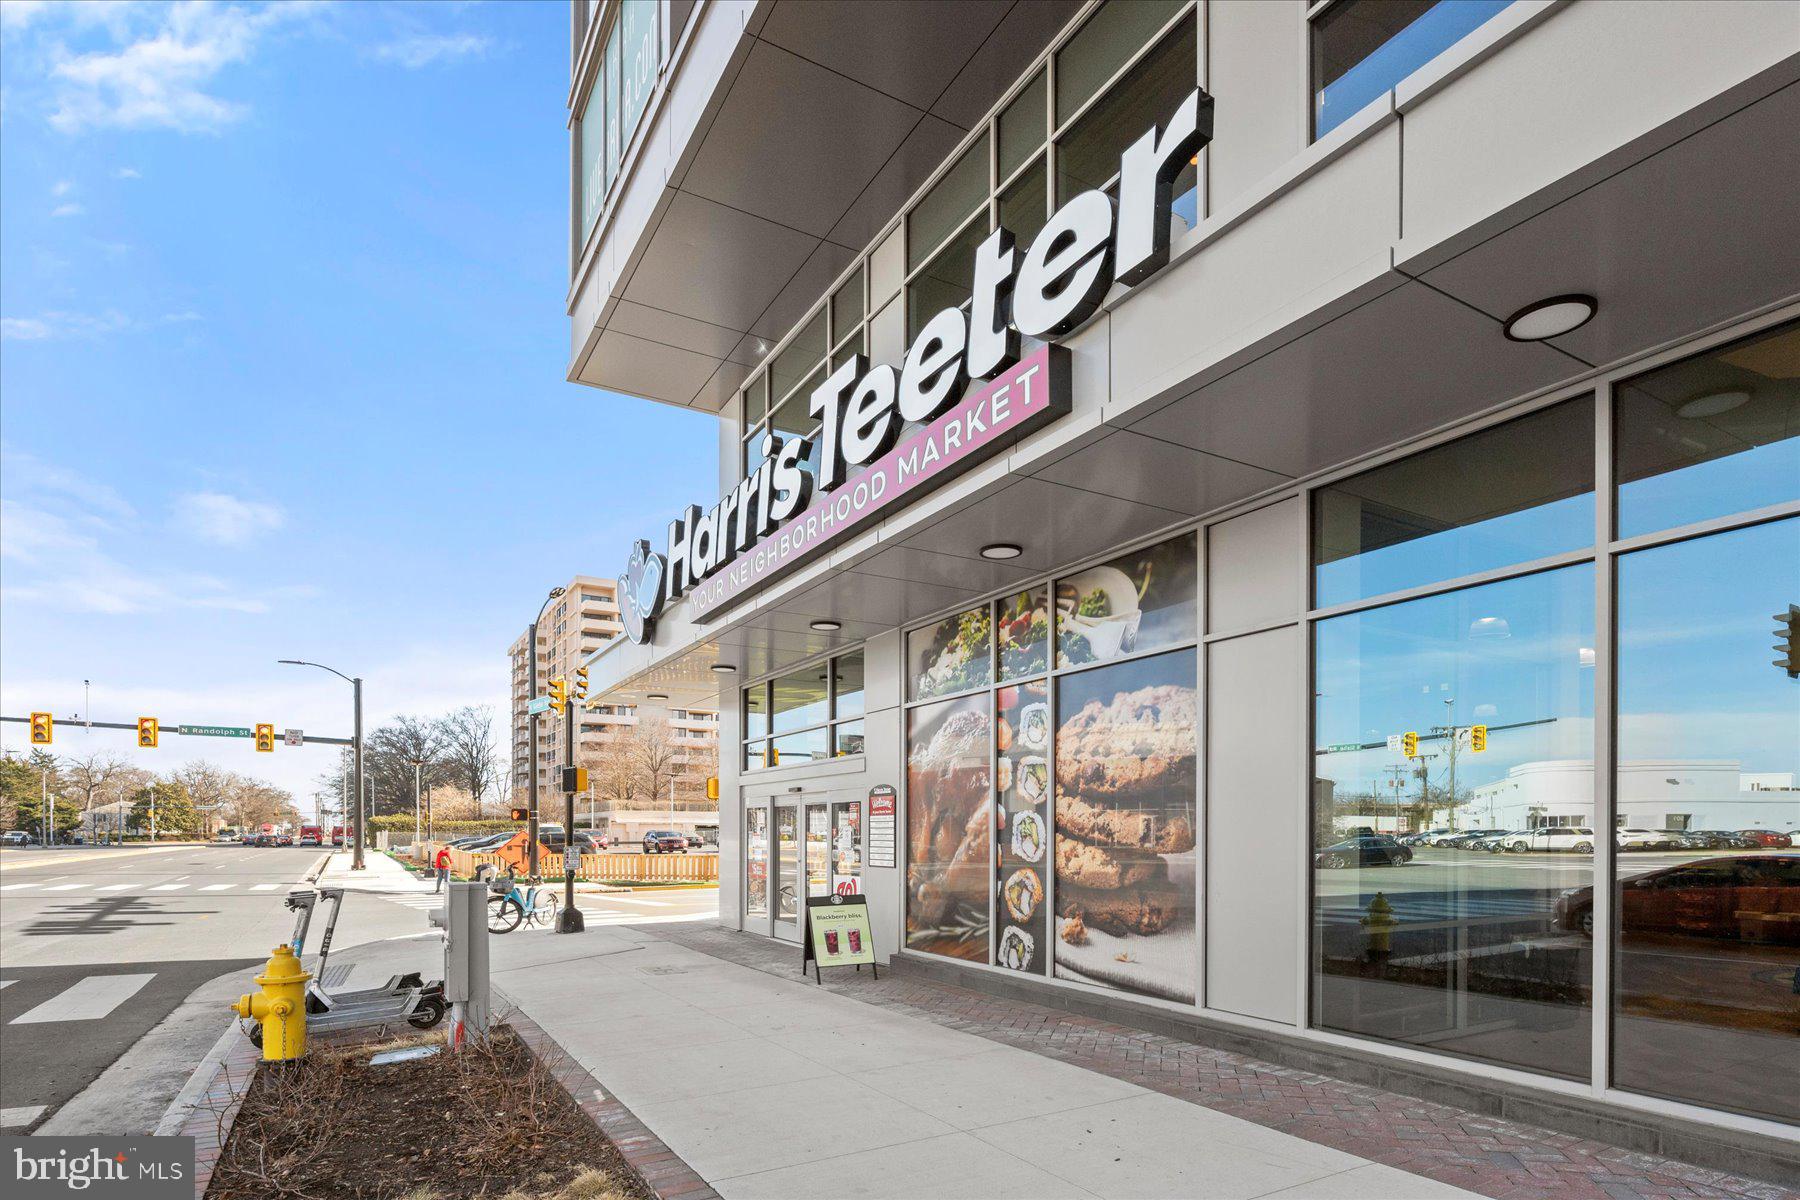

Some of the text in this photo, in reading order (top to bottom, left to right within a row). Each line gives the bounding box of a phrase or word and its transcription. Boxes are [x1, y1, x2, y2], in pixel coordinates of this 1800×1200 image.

[666, 86, 1214, 599] Harris Teeter
[691, 364, 1040, 614] YOUR NEIGHBORHOOD MARKET
[192, 728, 235, 736] Randolph
